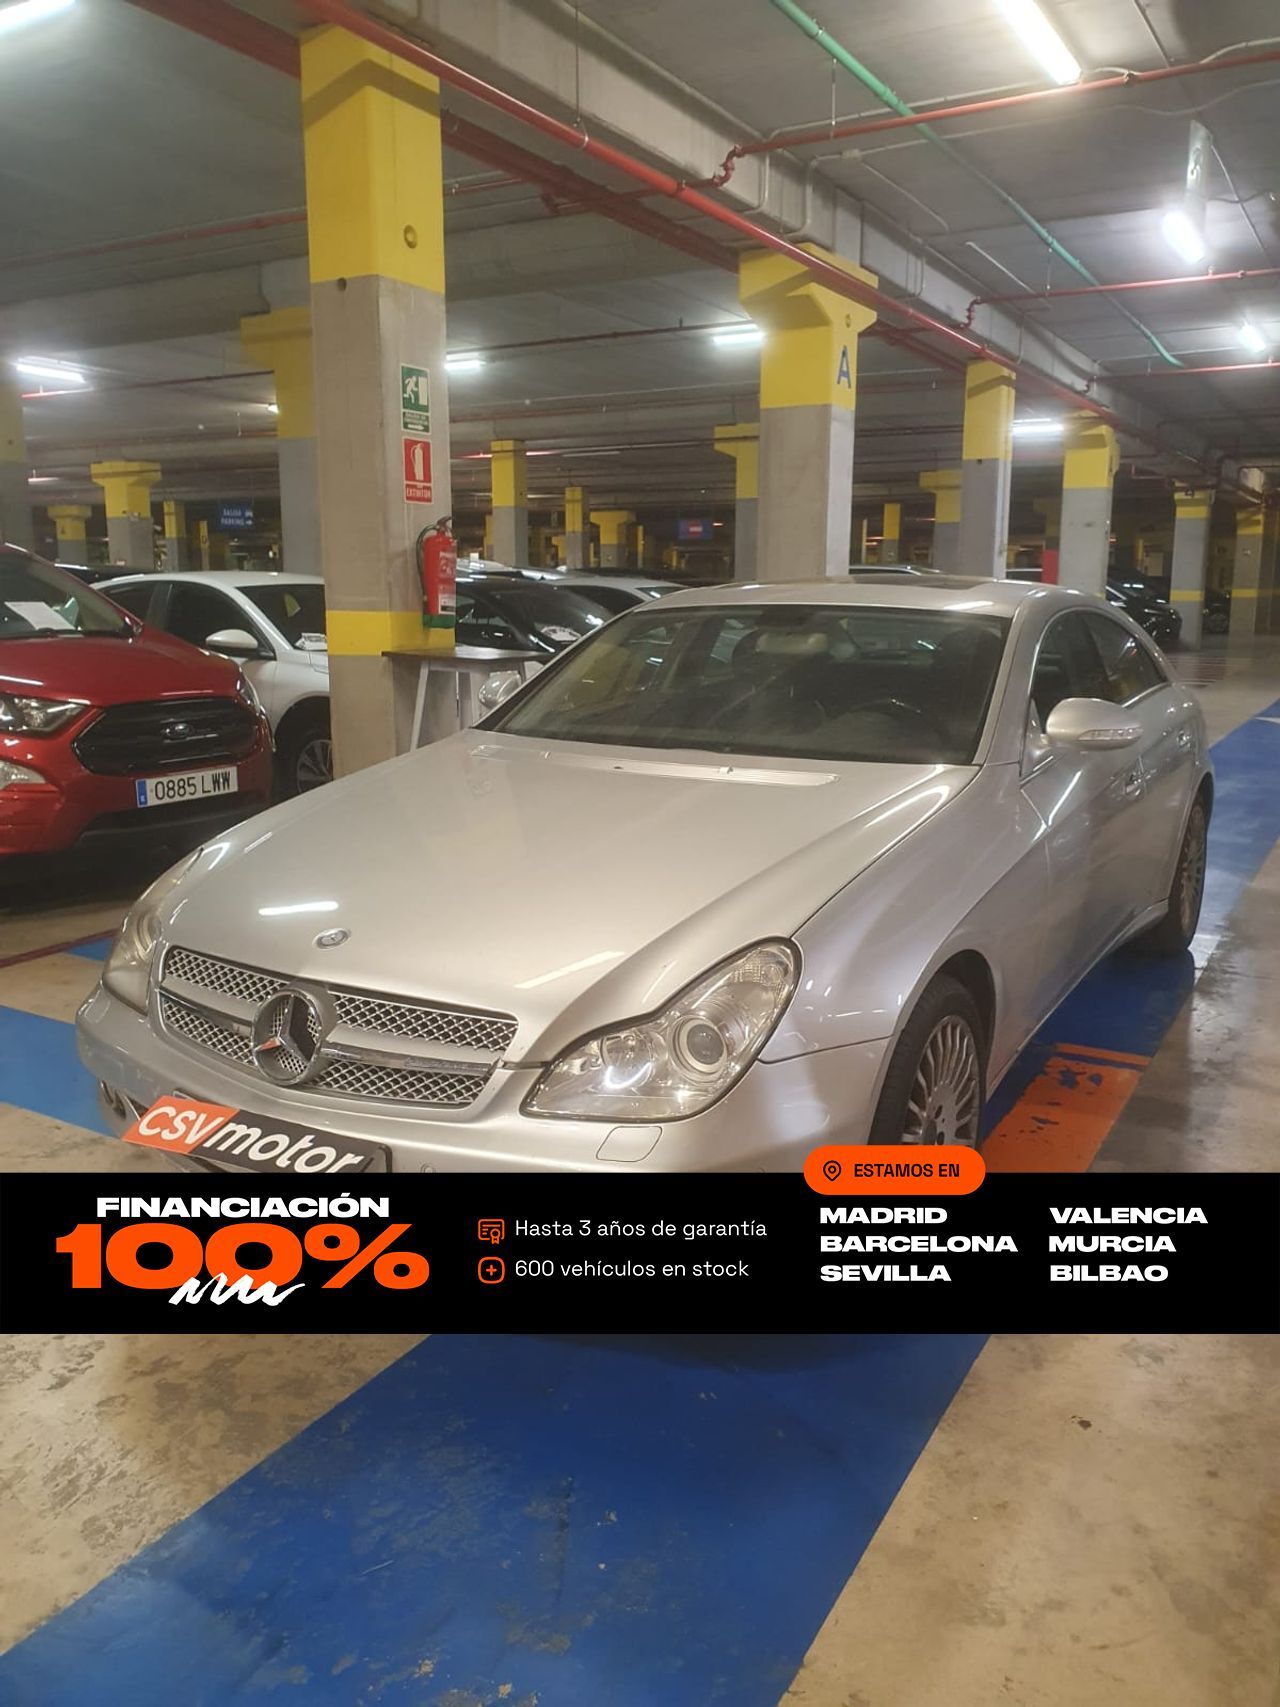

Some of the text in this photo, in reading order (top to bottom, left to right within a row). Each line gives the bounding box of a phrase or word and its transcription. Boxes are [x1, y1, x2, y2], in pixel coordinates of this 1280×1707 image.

[836, 344, 851, 389] A
[154, 771, 231, 800] 0885 LWW
